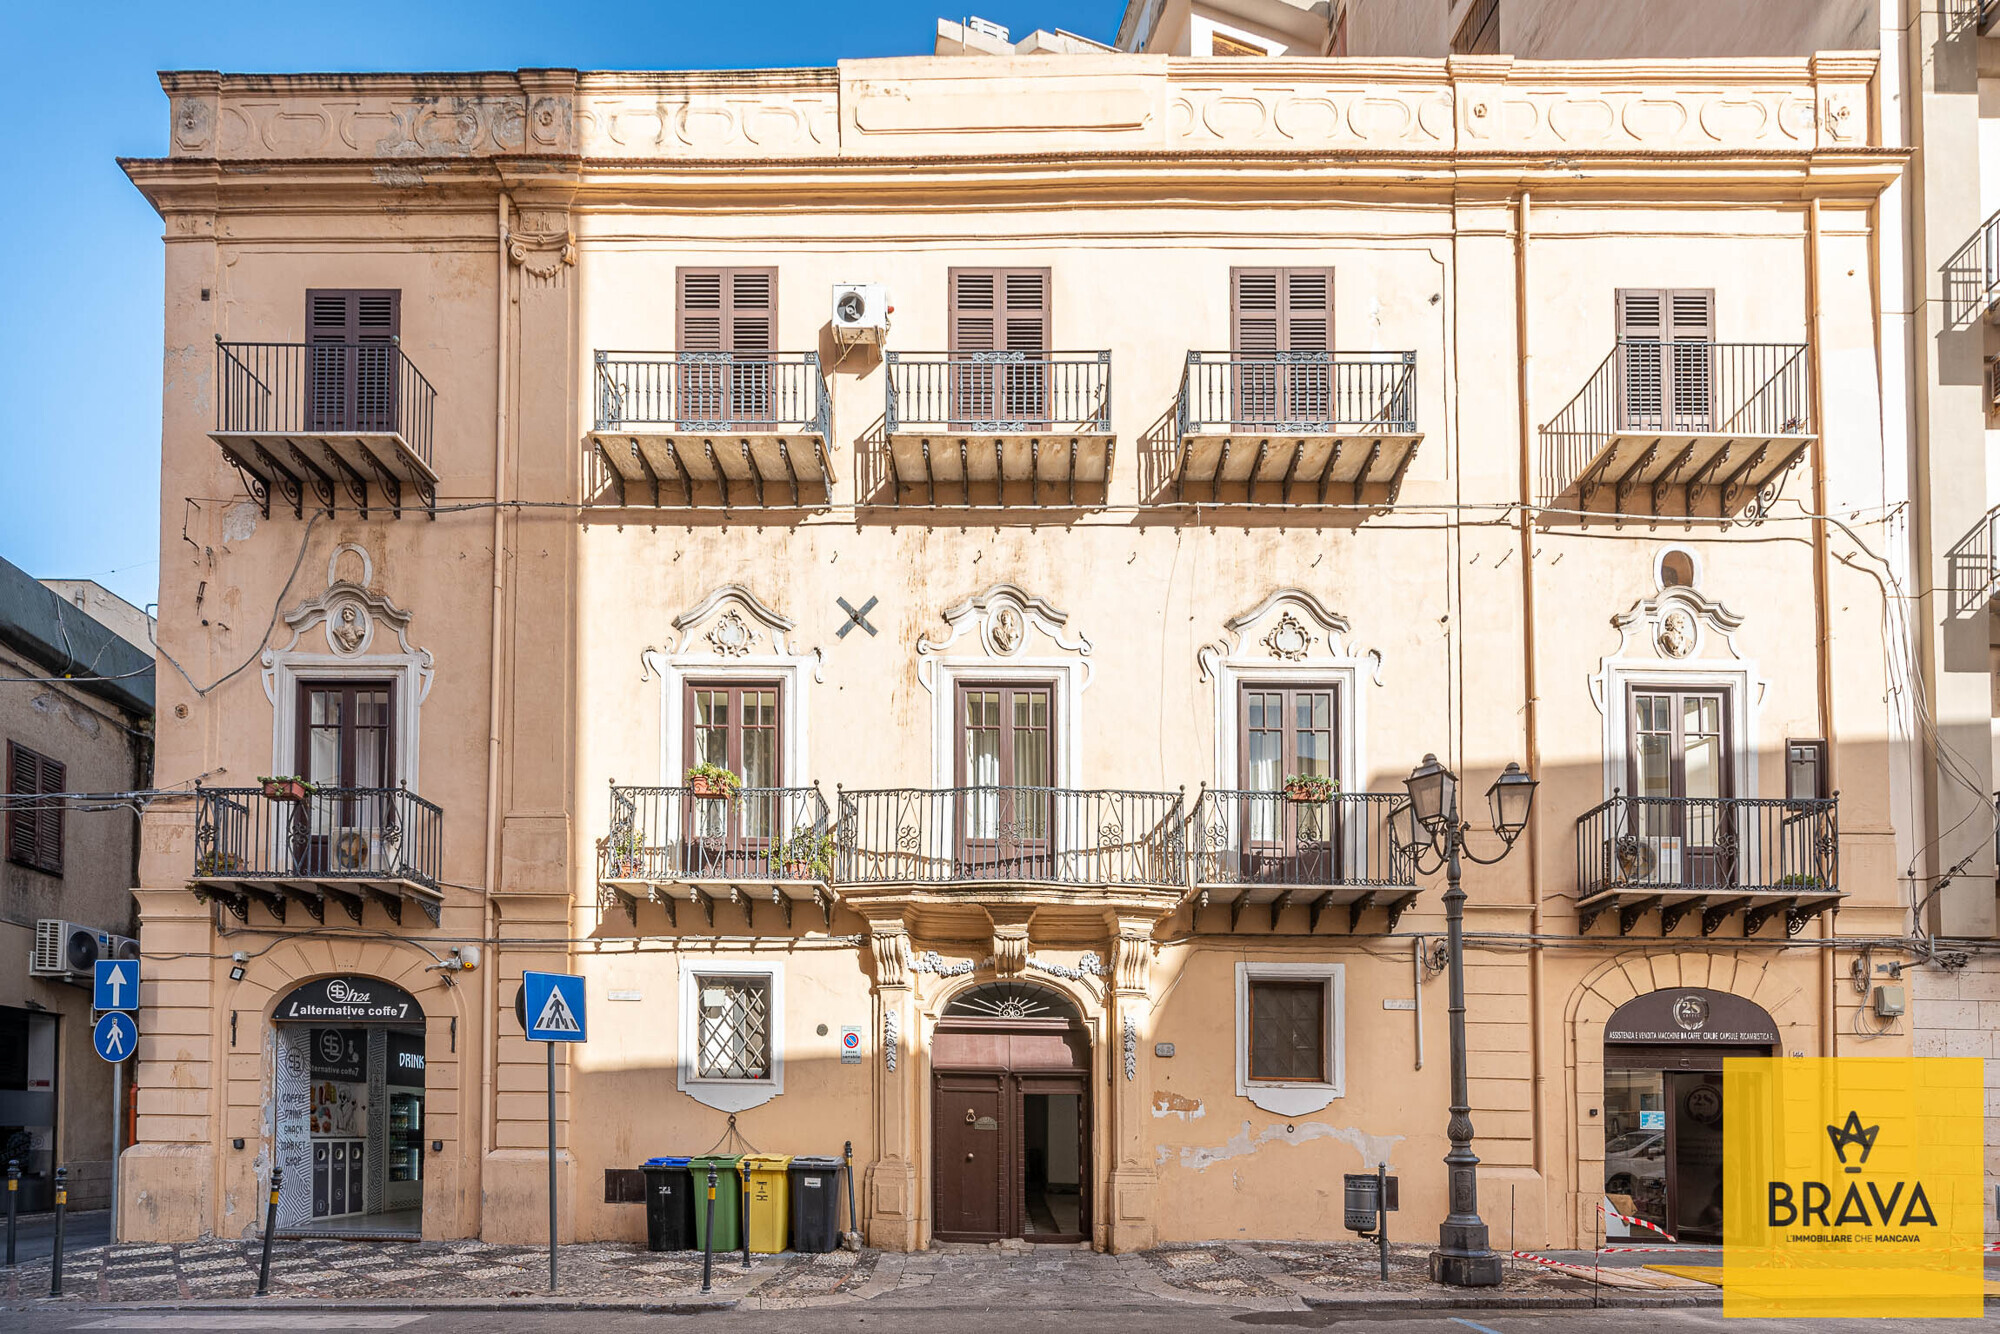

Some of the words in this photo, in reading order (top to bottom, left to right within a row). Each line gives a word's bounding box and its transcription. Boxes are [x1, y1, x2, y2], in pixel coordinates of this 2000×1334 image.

[1609, 1031, 1635, 1039] ASSISTENZA
[1638, 1031, 1657, 1039] VENDITA
[399, 1052, 425, 1070] DRINK
